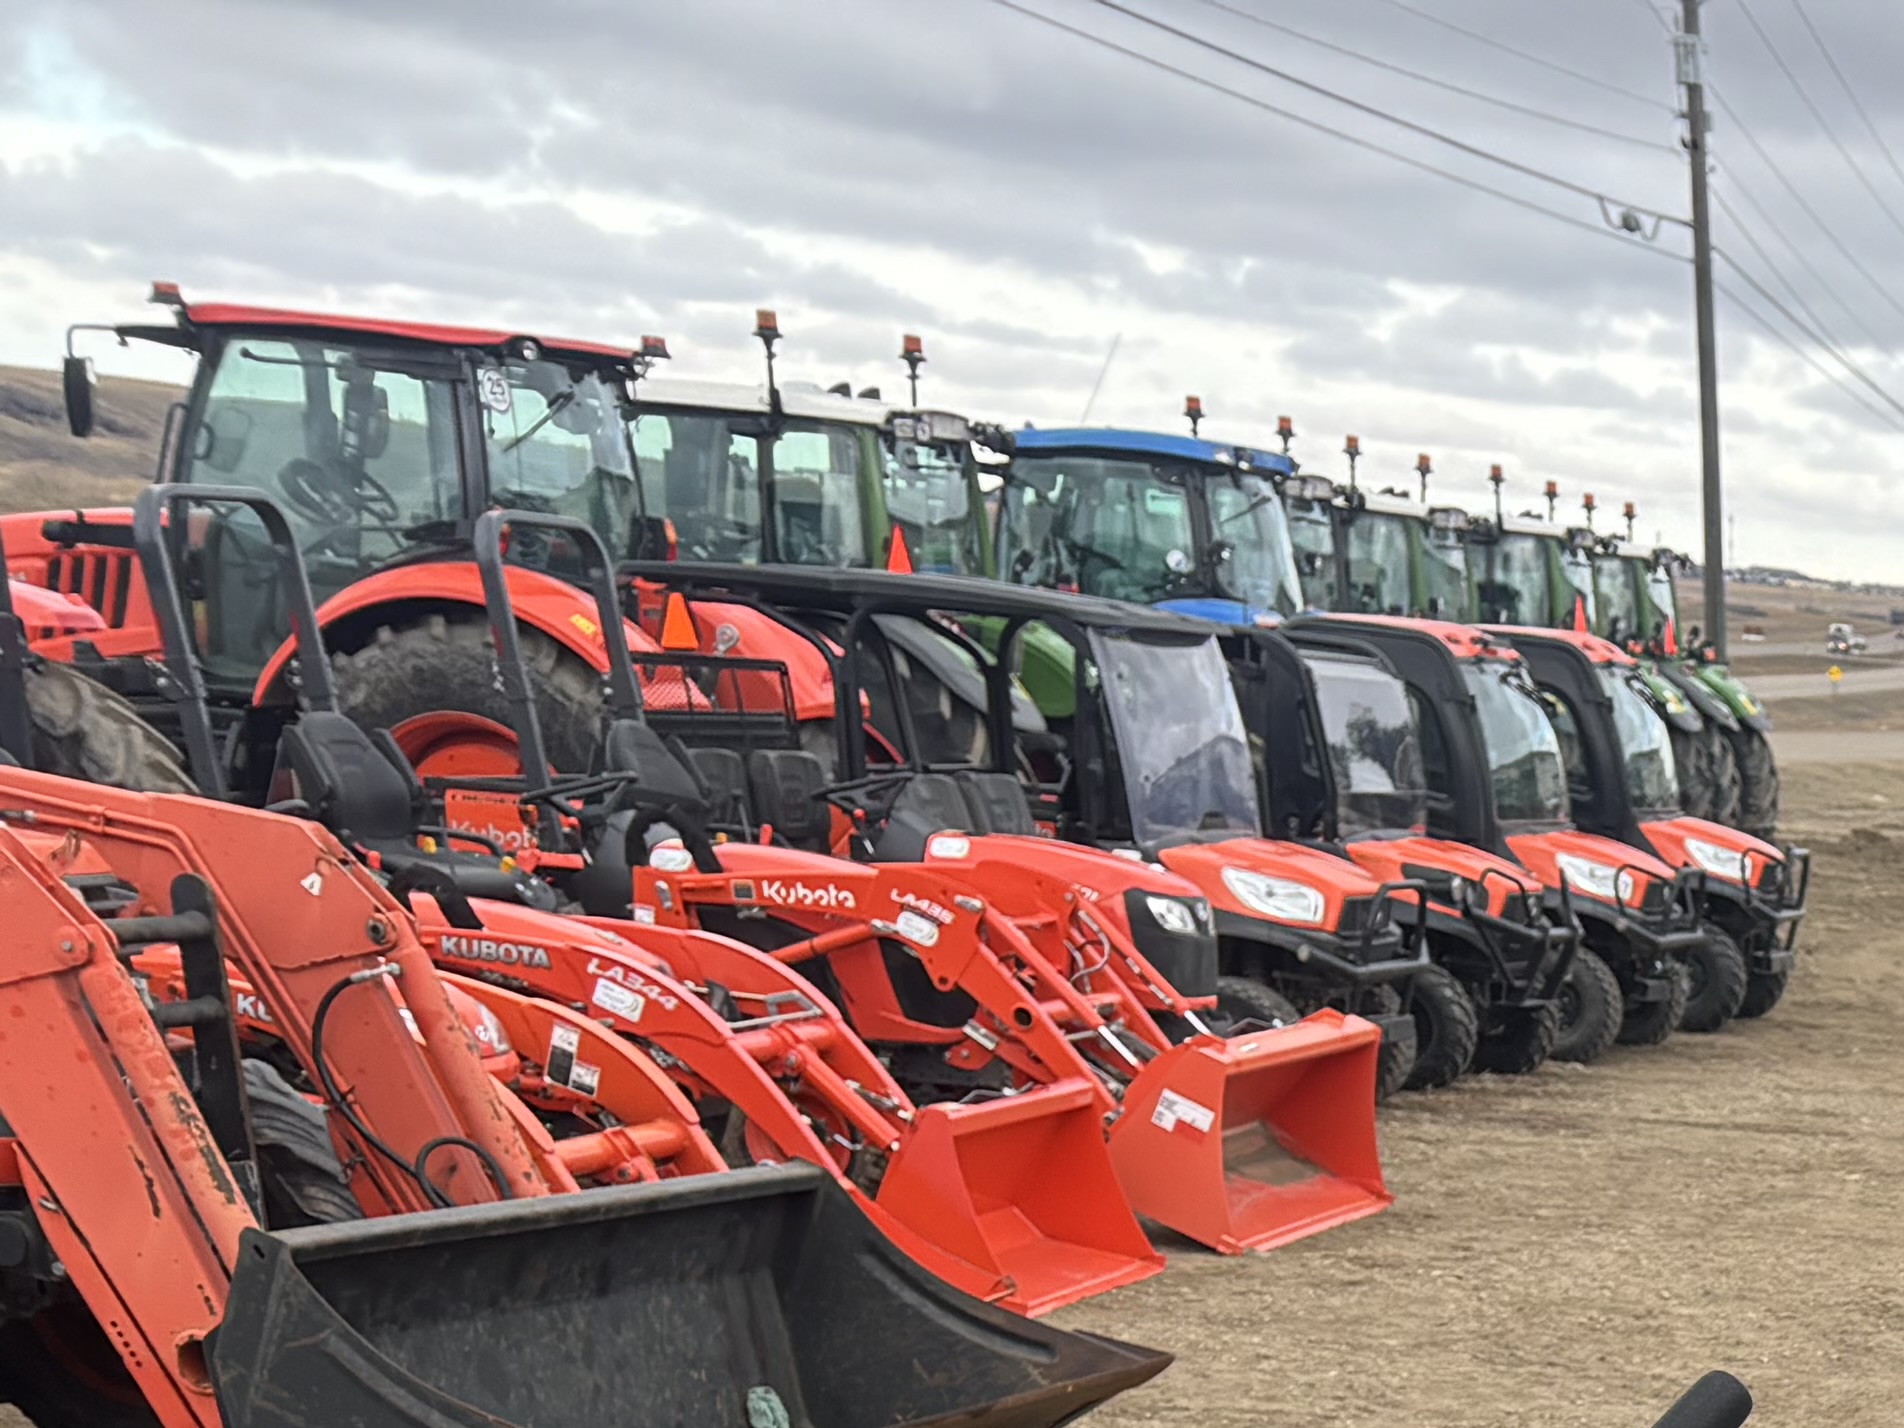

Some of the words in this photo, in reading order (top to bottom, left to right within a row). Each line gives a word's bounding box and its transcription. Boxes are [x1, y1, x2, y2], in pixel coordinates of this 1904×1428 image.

[762, 880, 855, 909] Kubota
[440, 936, 552, 968] KUBOTA
[586, 957, 680, 1012] LA344
